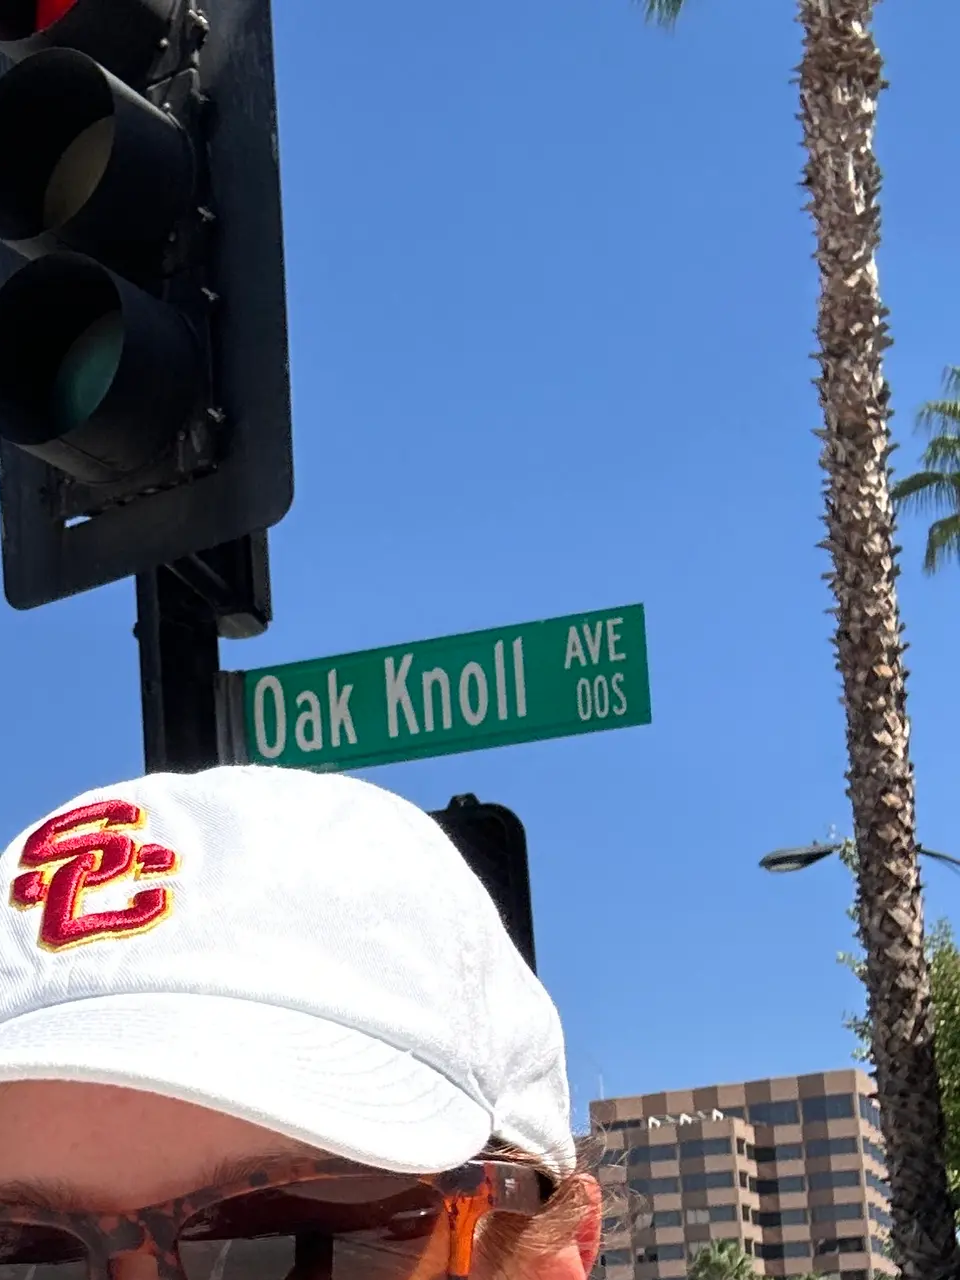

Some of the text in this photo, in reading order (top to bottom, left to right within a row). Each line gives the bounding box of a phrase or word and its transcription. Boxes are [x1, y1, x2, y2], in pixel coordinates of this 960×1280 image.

[254, 617, 627, 759] Oak Knoll AVE
